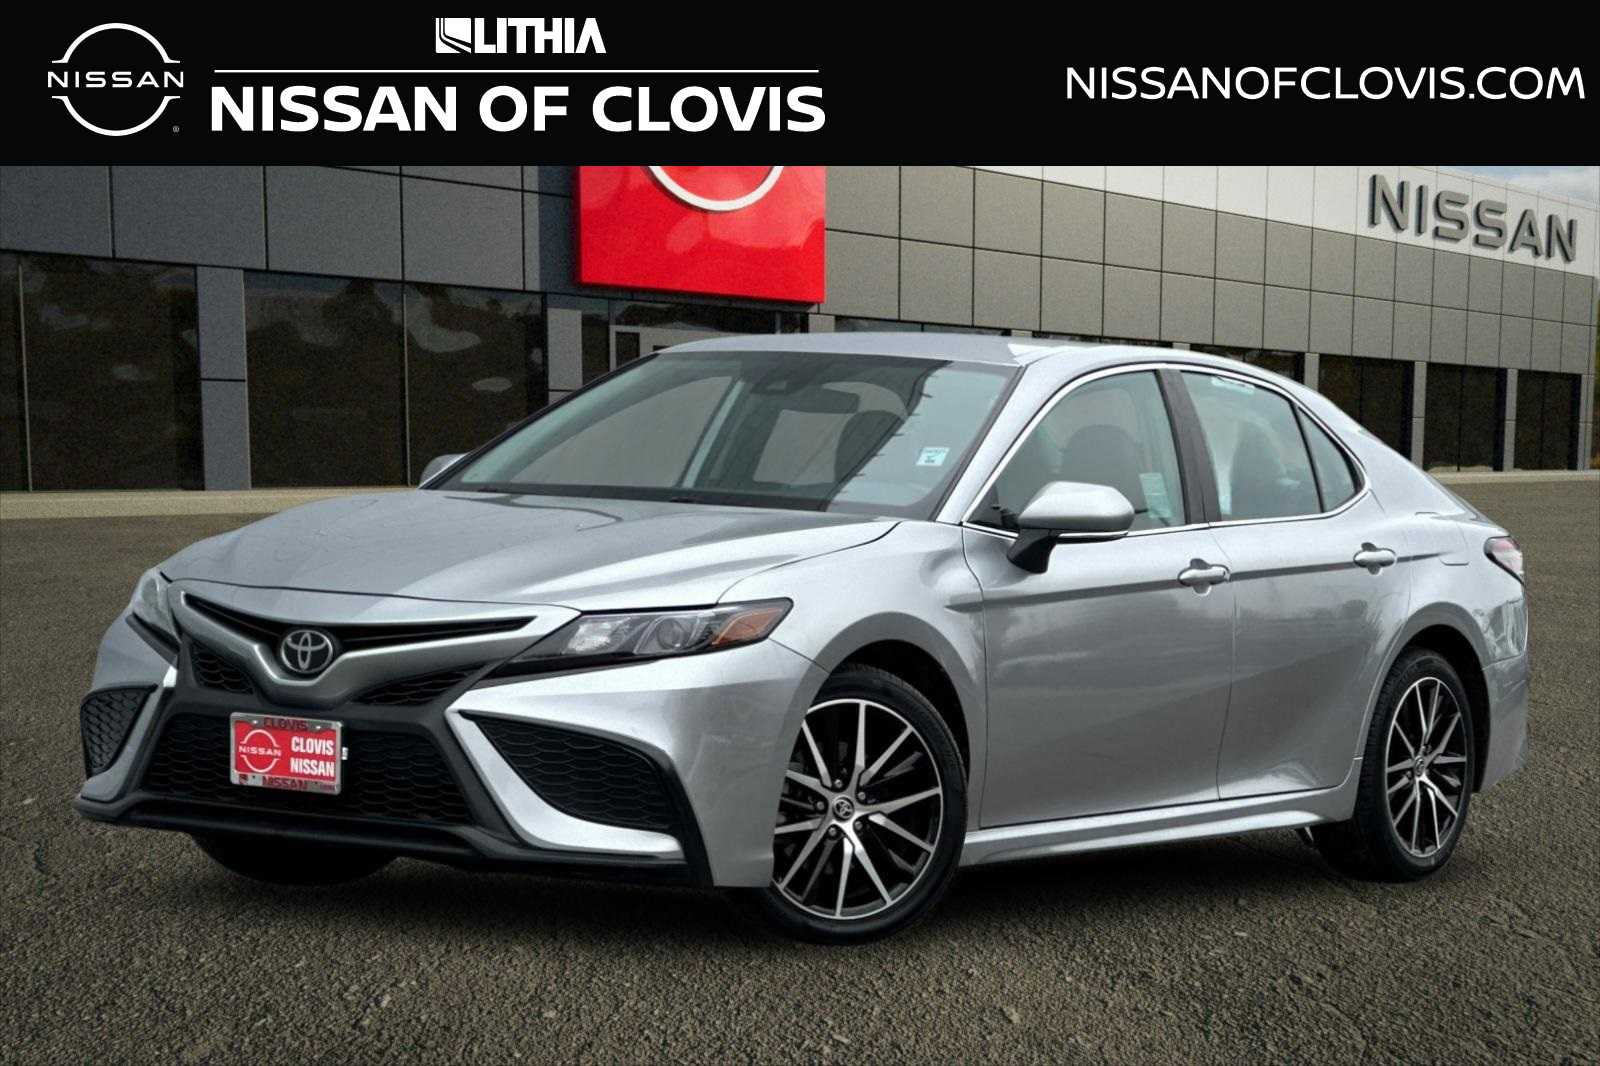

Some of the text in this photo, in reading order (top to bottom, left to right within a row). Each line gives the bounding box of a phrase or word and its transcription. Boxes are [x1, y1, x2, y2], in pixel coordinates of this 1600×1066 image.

[1369, 173, 1578, 265] NISSAN
[238, 745, 282, 757] NISSAN
[291, 736, 334, 756] CLOVIS
[290, 757, 335, 777] NISSAN
[262, 775, 308, 790] NISSAN
